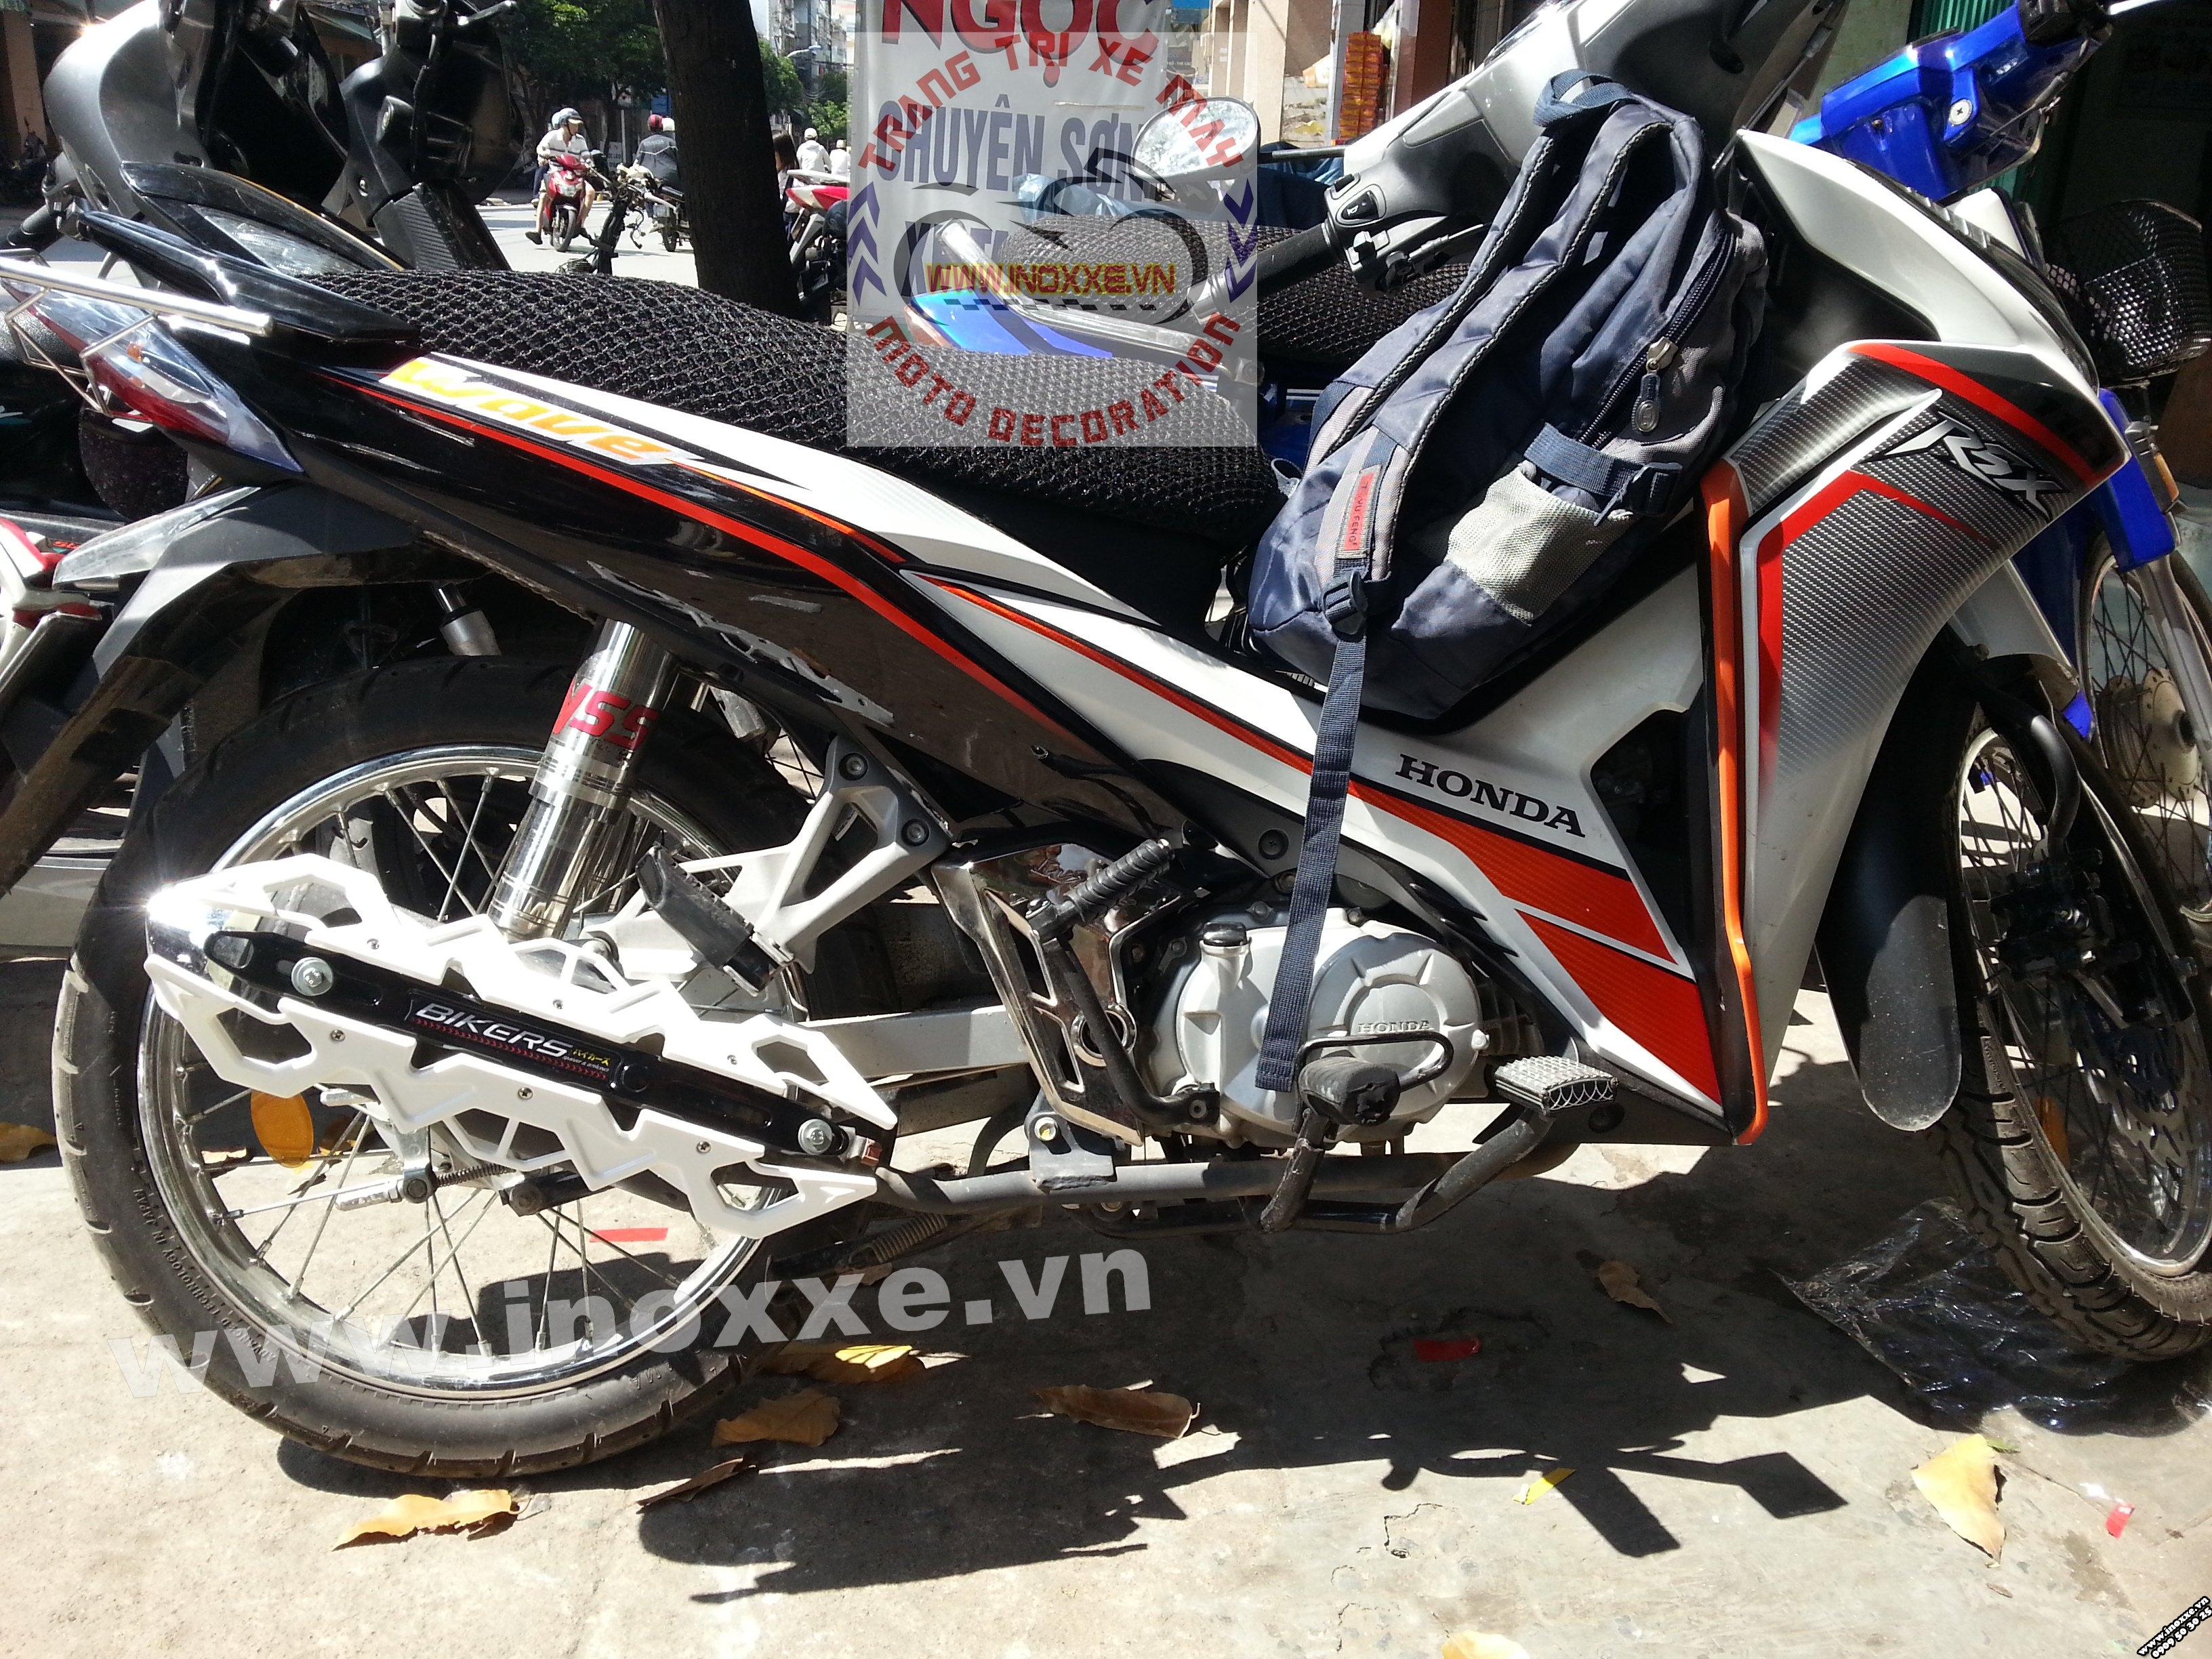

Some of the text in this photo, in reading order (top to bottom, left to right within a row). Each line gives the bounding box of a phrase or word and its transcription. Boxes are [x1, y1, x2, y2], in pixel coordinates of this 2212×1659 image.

[877, 94, 1045, 192] CHUYÊN
[1883, 410, 2064, 520] RSX
[1395, 753, 1586, 838] HONDA
[415, 1003, 573, 1057] BIKERS
[1357, 1020, 1434, 1034] HONDA
[134, 1188, 159, 1228] JAPAN
[152, 1230, 167, 1246] IN
